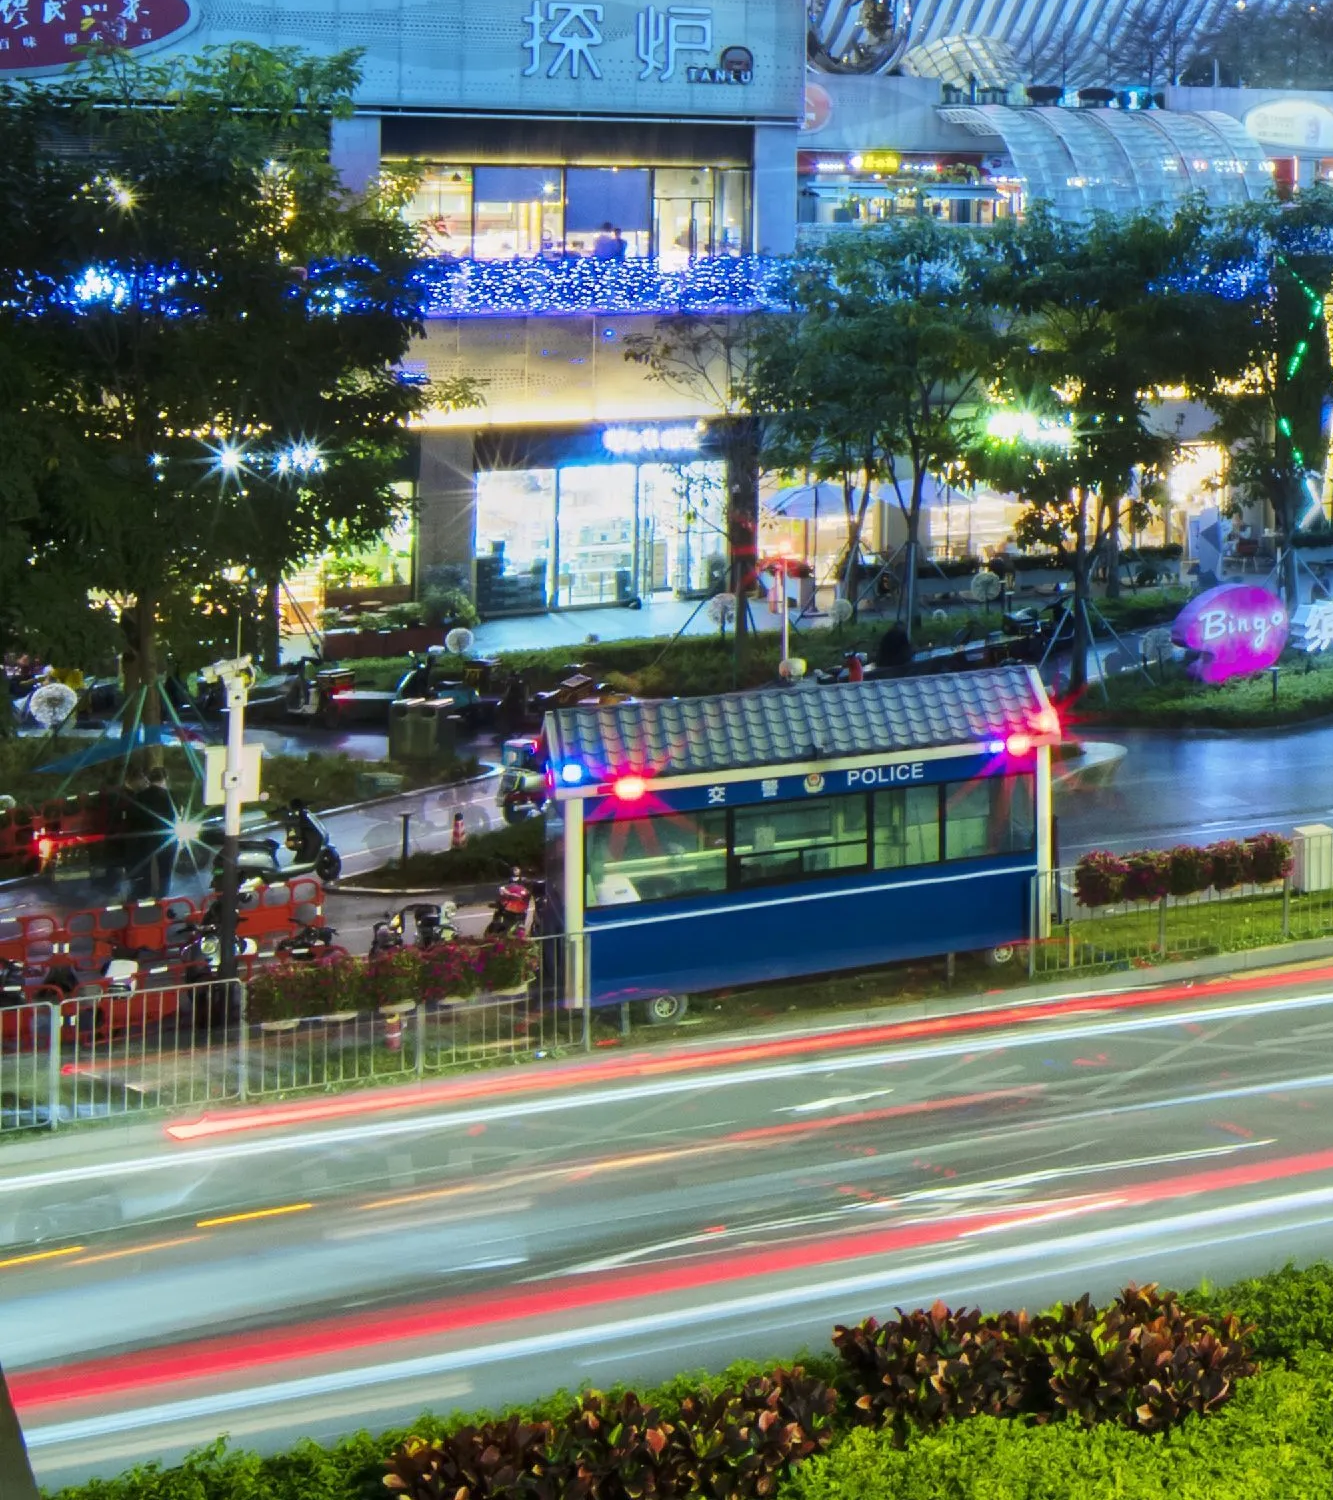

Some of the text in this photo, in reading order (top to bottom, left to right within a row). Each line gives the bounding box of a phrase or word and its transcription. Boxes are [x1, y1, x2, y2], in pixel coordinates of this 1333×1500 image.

[688, 67, 753, 84] TANLU
[1200, 609, 1284, 649] Bingo
[707, 762, 925, 805] 交警 POLICE
